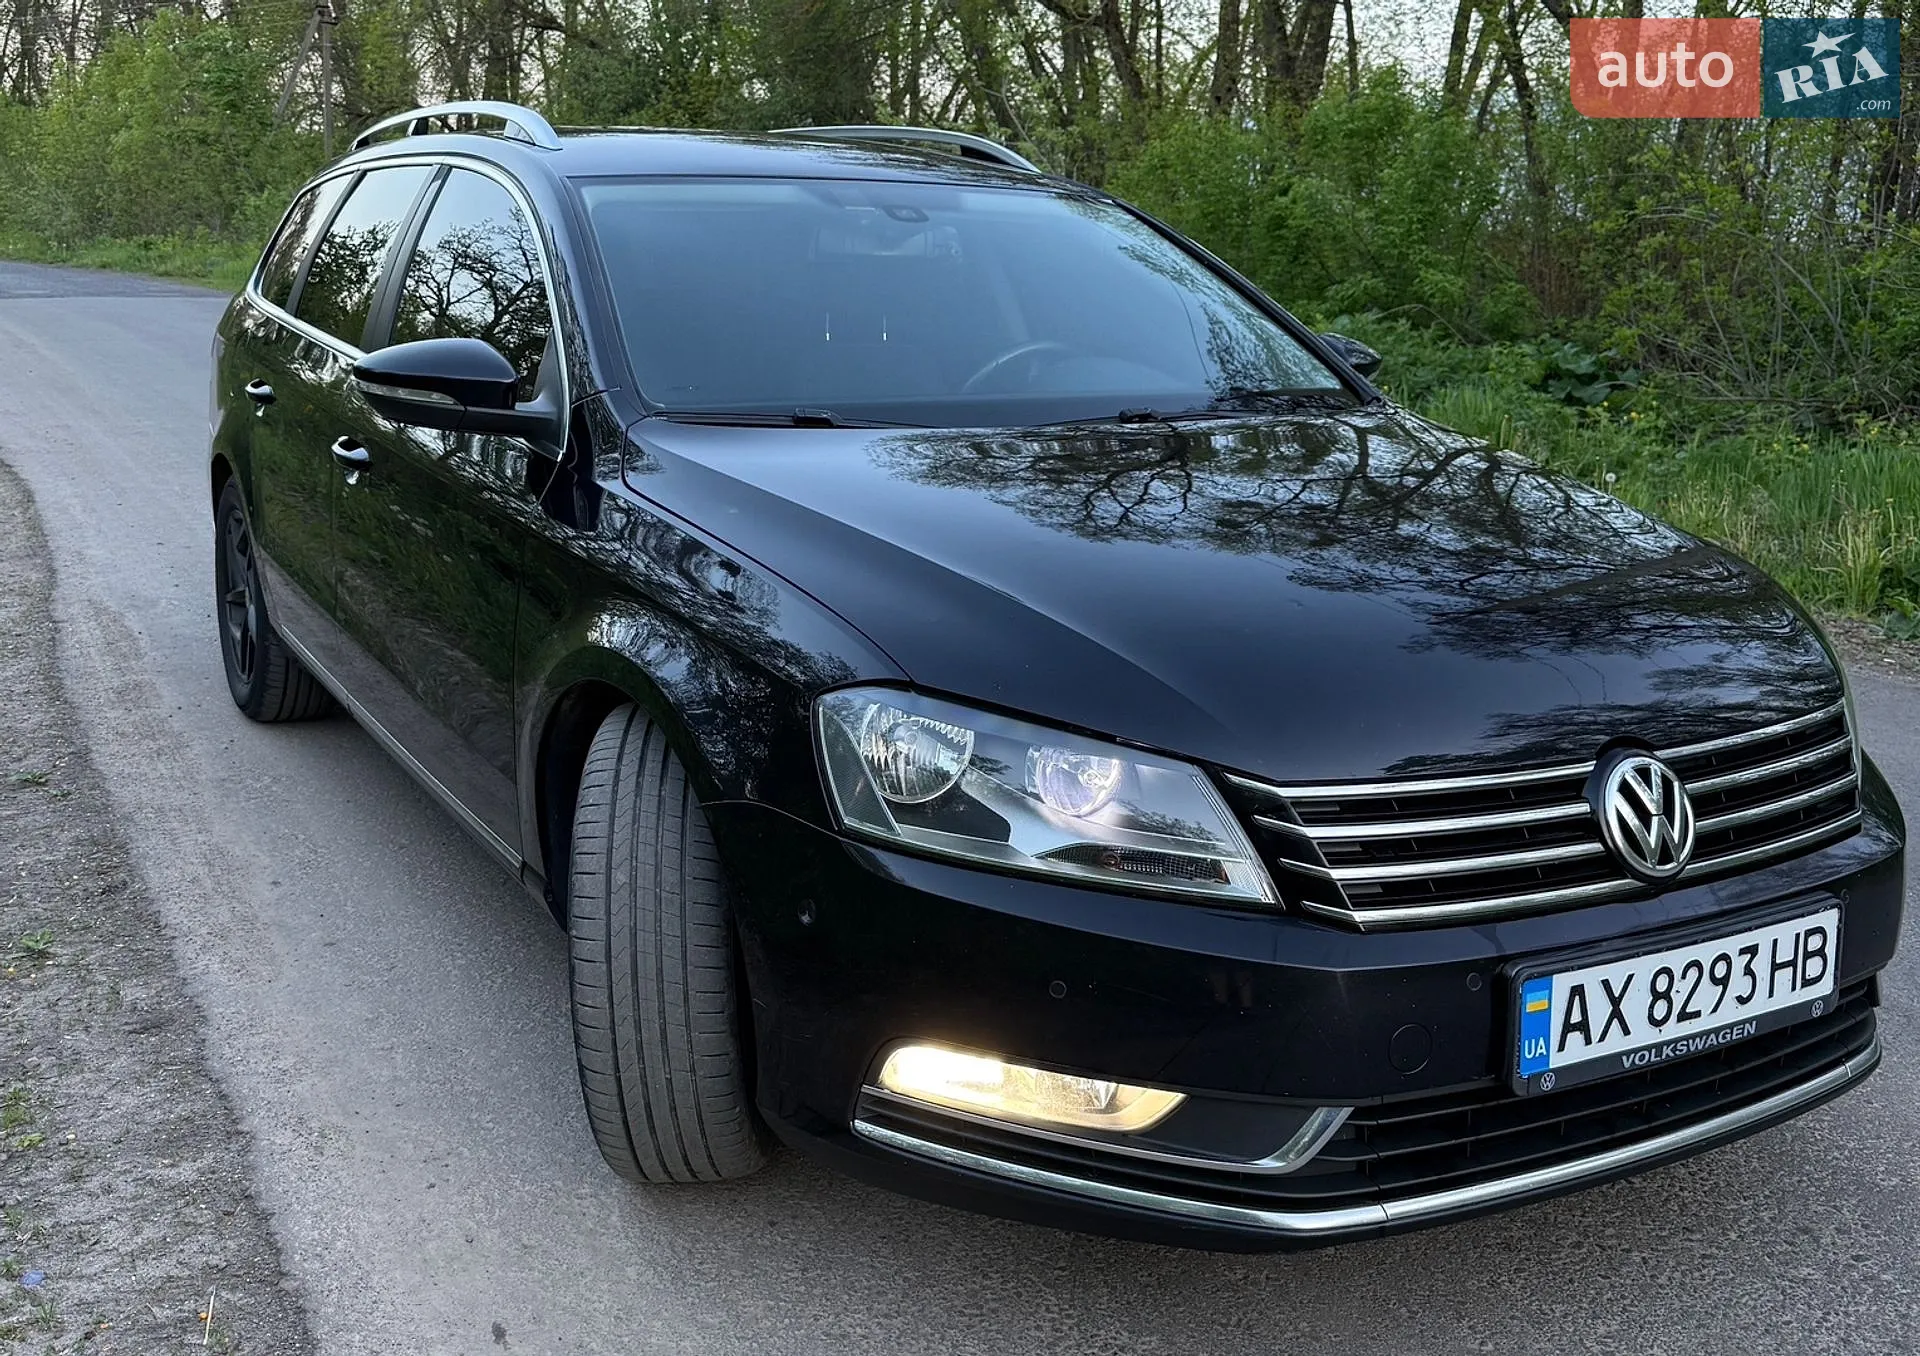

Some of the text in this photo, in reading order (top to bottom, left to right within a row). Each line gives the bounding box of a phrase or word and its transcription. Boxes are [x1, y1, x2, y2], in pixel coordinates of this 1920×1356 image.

[1556, 925, 1828, 1053] AX 8293 HB
[1524, 1037, 1547, 1060] UA
[1621, 1020, 1757, 1068] VOLKSWAGEN
